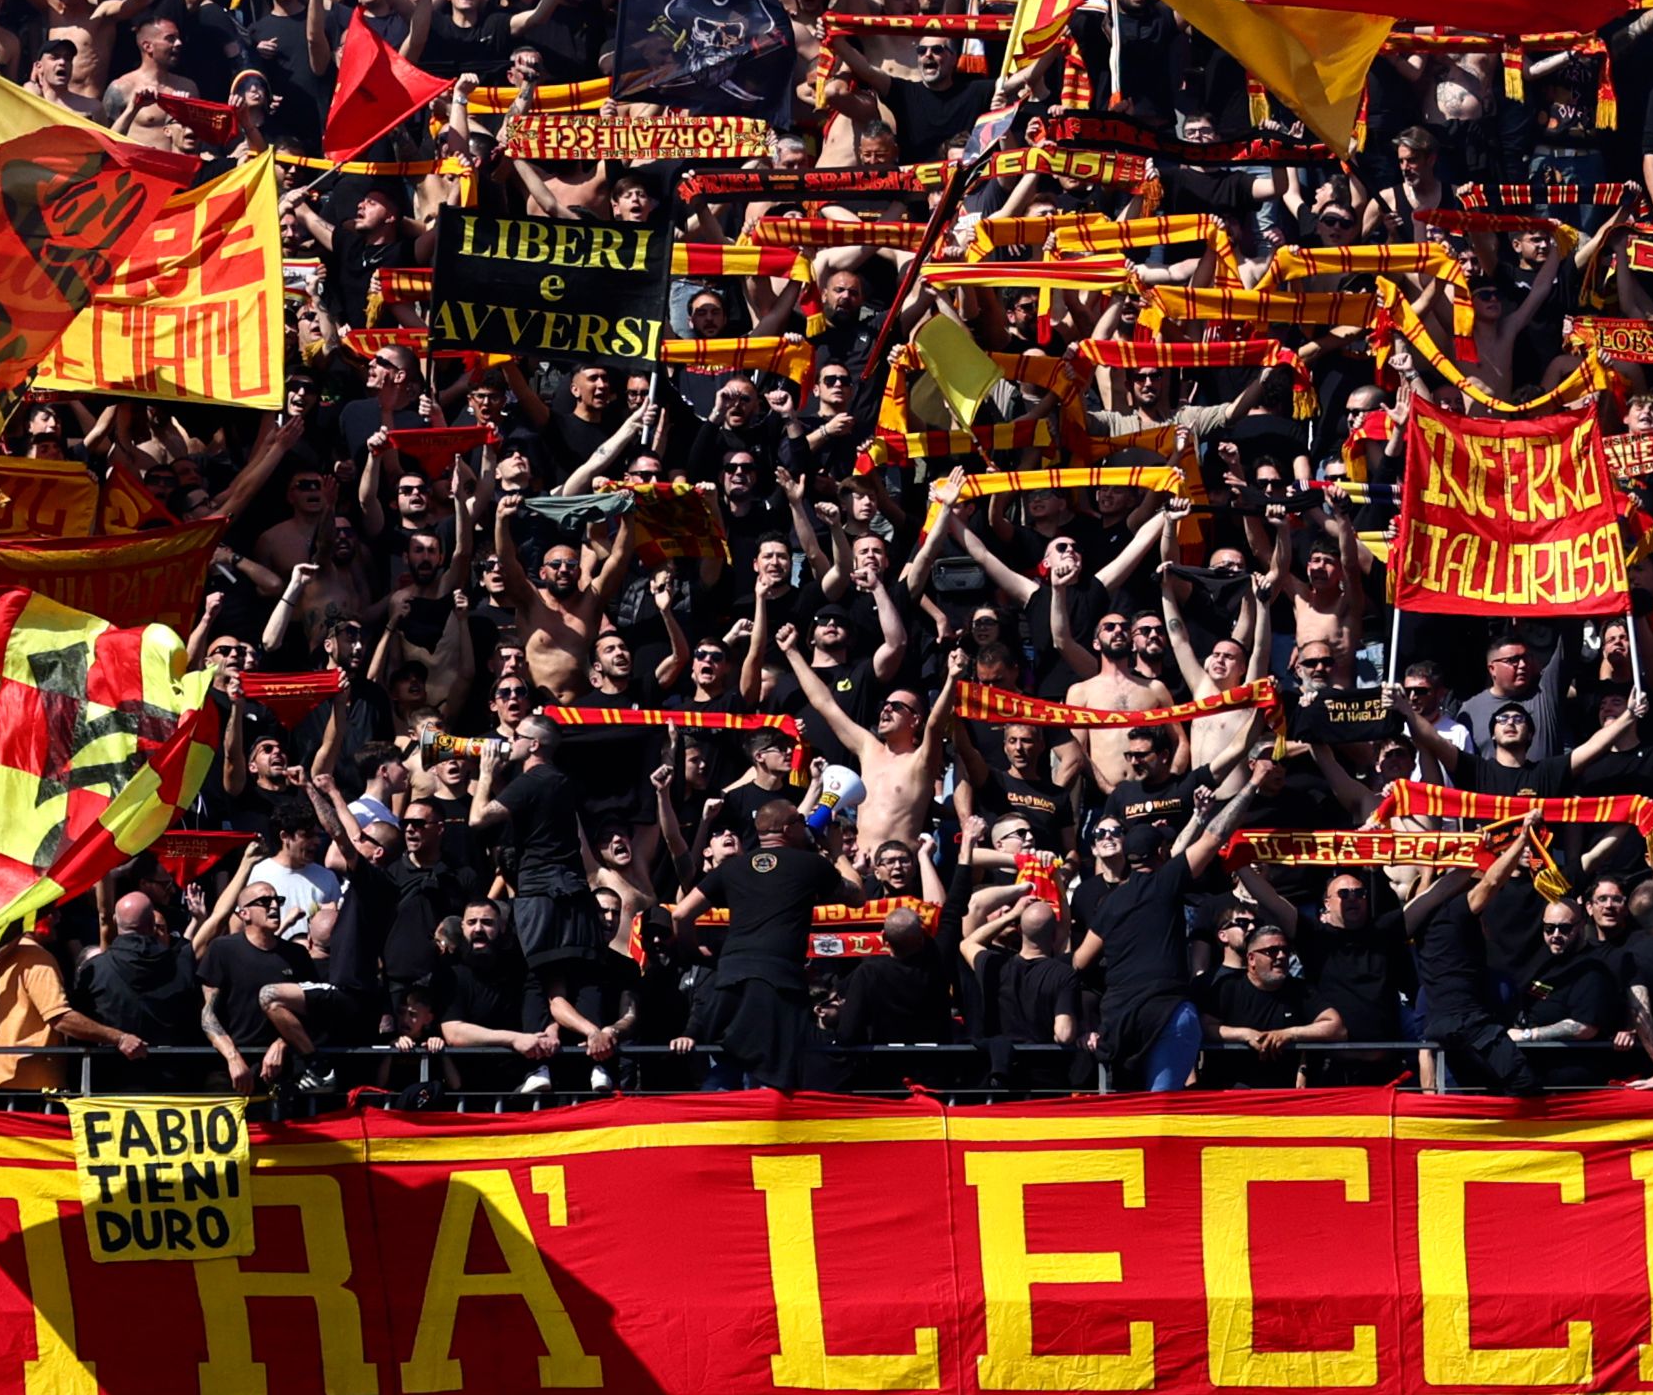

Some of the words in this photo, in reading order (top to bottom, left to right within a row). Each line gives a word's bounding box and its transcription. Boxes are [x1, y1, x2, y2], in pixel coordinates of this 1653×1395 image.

[543, 125, 630, 150] LECCE
[634, 125, 737, 150] FORZA
[458, 215, 655, 273] LIBERI
[539, 272, 567, 302] e
[432, 300, 663, 363] AVVERSI
[1417, 415, 1602, 524] INFERNO
[1407, 519, 1627, 605] GIALLOROSSO
[994, 692, 1130, 724] ULTRA
[1143, 677, 1276, 722] LECCE
[1371, 833, 1480, 863] LECCE
[85, 1105, 240, 1159] FABIO
[89, 1159, 243, 1207] TIENI
[97, 1208, 233, 1253] DURO
